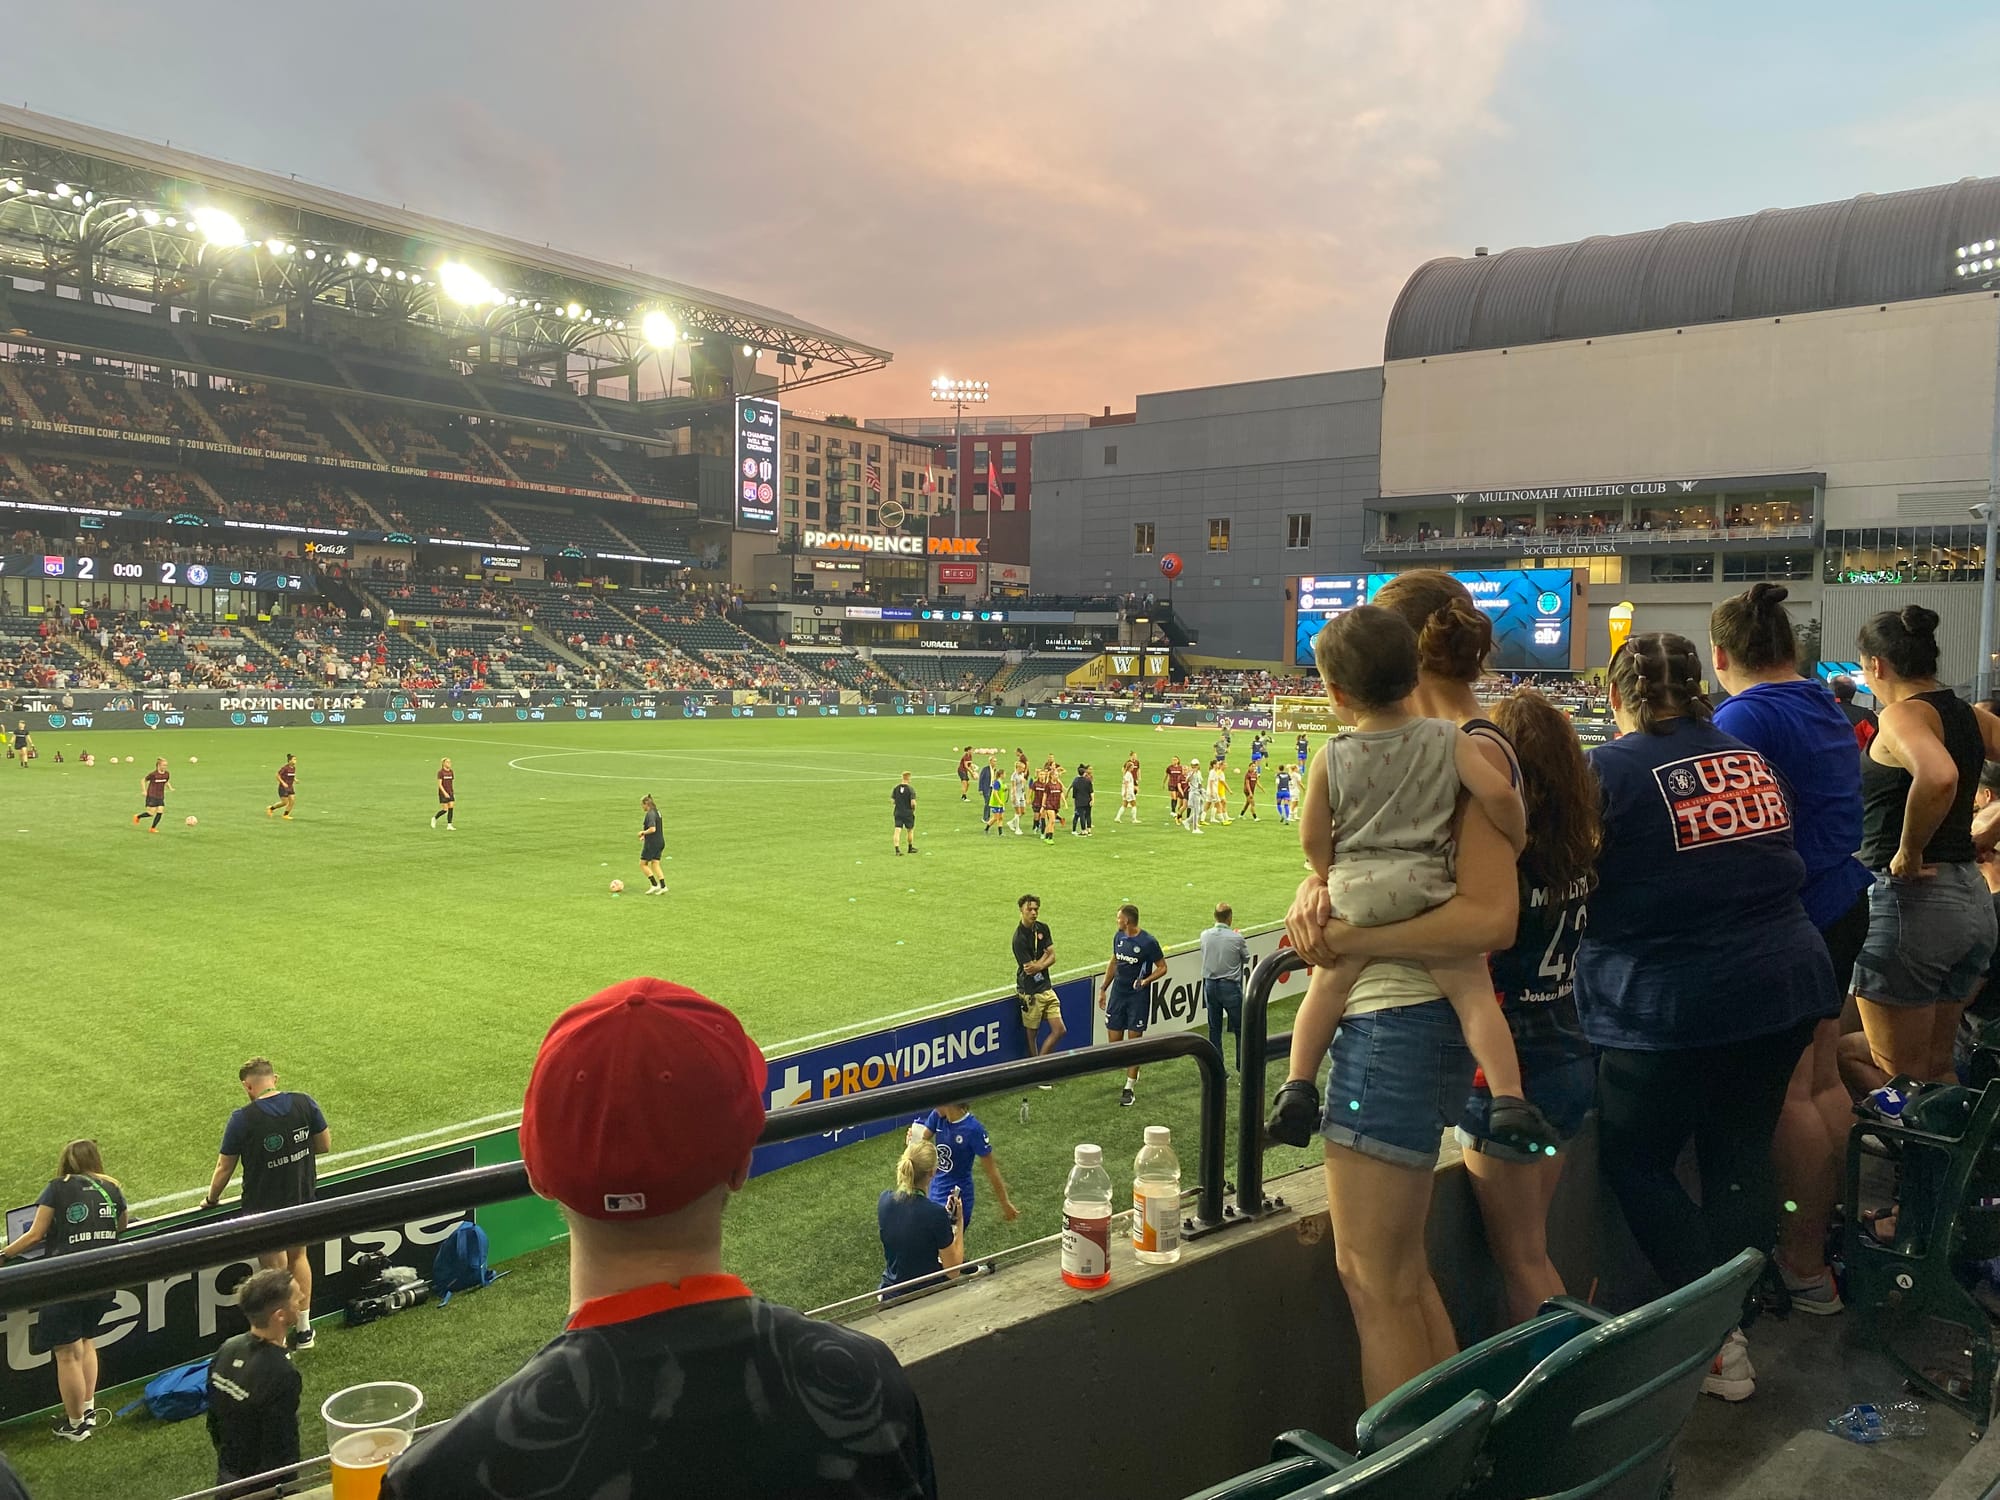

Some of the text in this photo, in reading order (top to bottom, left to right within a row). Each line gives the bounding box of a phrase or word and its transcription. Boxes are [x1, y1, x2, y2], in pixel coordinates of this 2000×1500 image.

[31, 420, 171, 446] 2015 WESTERN CONF. CHAMPIONS
[205, 441, 242, 455] WESTERN
[243, 447, 264, 458] CONF.
[265, 450, 307, 463] CHAMPIONS
[322, 456, 337, 466] 2021
[339, 459, 372, 471] WESTERN
[392, 465, 428, 477] CHAMPIONS
[1479, 482, 1667, 503] MULTNOMAH ATHLETIC CLUB
[803, 530, 982, 556] PROVIDENCE PARK
[1523, 544, 1616, 556] SOCCER CITY USA
[46, 557, 177, 584] OL 2 0:00 2
[1161, 559, 1174, 570] 76
[244, 575, 257, 586] ally
[1356, 578, 1365, 590] 2
[920, 640, 959, 649] DURACELL
[1089, 660, 1104, 680] Hefe
[1111, 656, 1135, 674] W
[1149, 656, 1164, 674] W
[220, 697, 317, 711] PROVIDENC
[71, 715, 93, 728] ally
[165, 714, 185, 726] ally
[250, 713, 269, 725] ally
[328, 712, 346, 724] ally
[400, 711, 417, 722] ally
[467, 711, 483, 721] ally
[531, 710, 545, 720] ally
[1163, 715, 1175, 725] ally
[1238, 717, 1253, 728] ally
[1257, 717, 1273, 729] ally
[1297, 721, 1327, 731] verizon
[1578, 734, 1607, 742] TOYOTA
[1693, 754, 1775, 793] USA
[1678, 801, 1692, 809] LAS
[1692, 797, 1712, 806] VEGAS
[1718, 789, 1750, 800] CHARLOTTE
[1676, 791, 1786, 841] TOUR
[823, 1021, 1000, 1101] PROVIDENCE
[293, 1128, 310, 1142] ally
[267, 1148, 310, 1169] CLUB MEDIA
[68, 1229, 117, 1245] CLUB MEDIA
[1900, 1276, 1910, 1287] A
